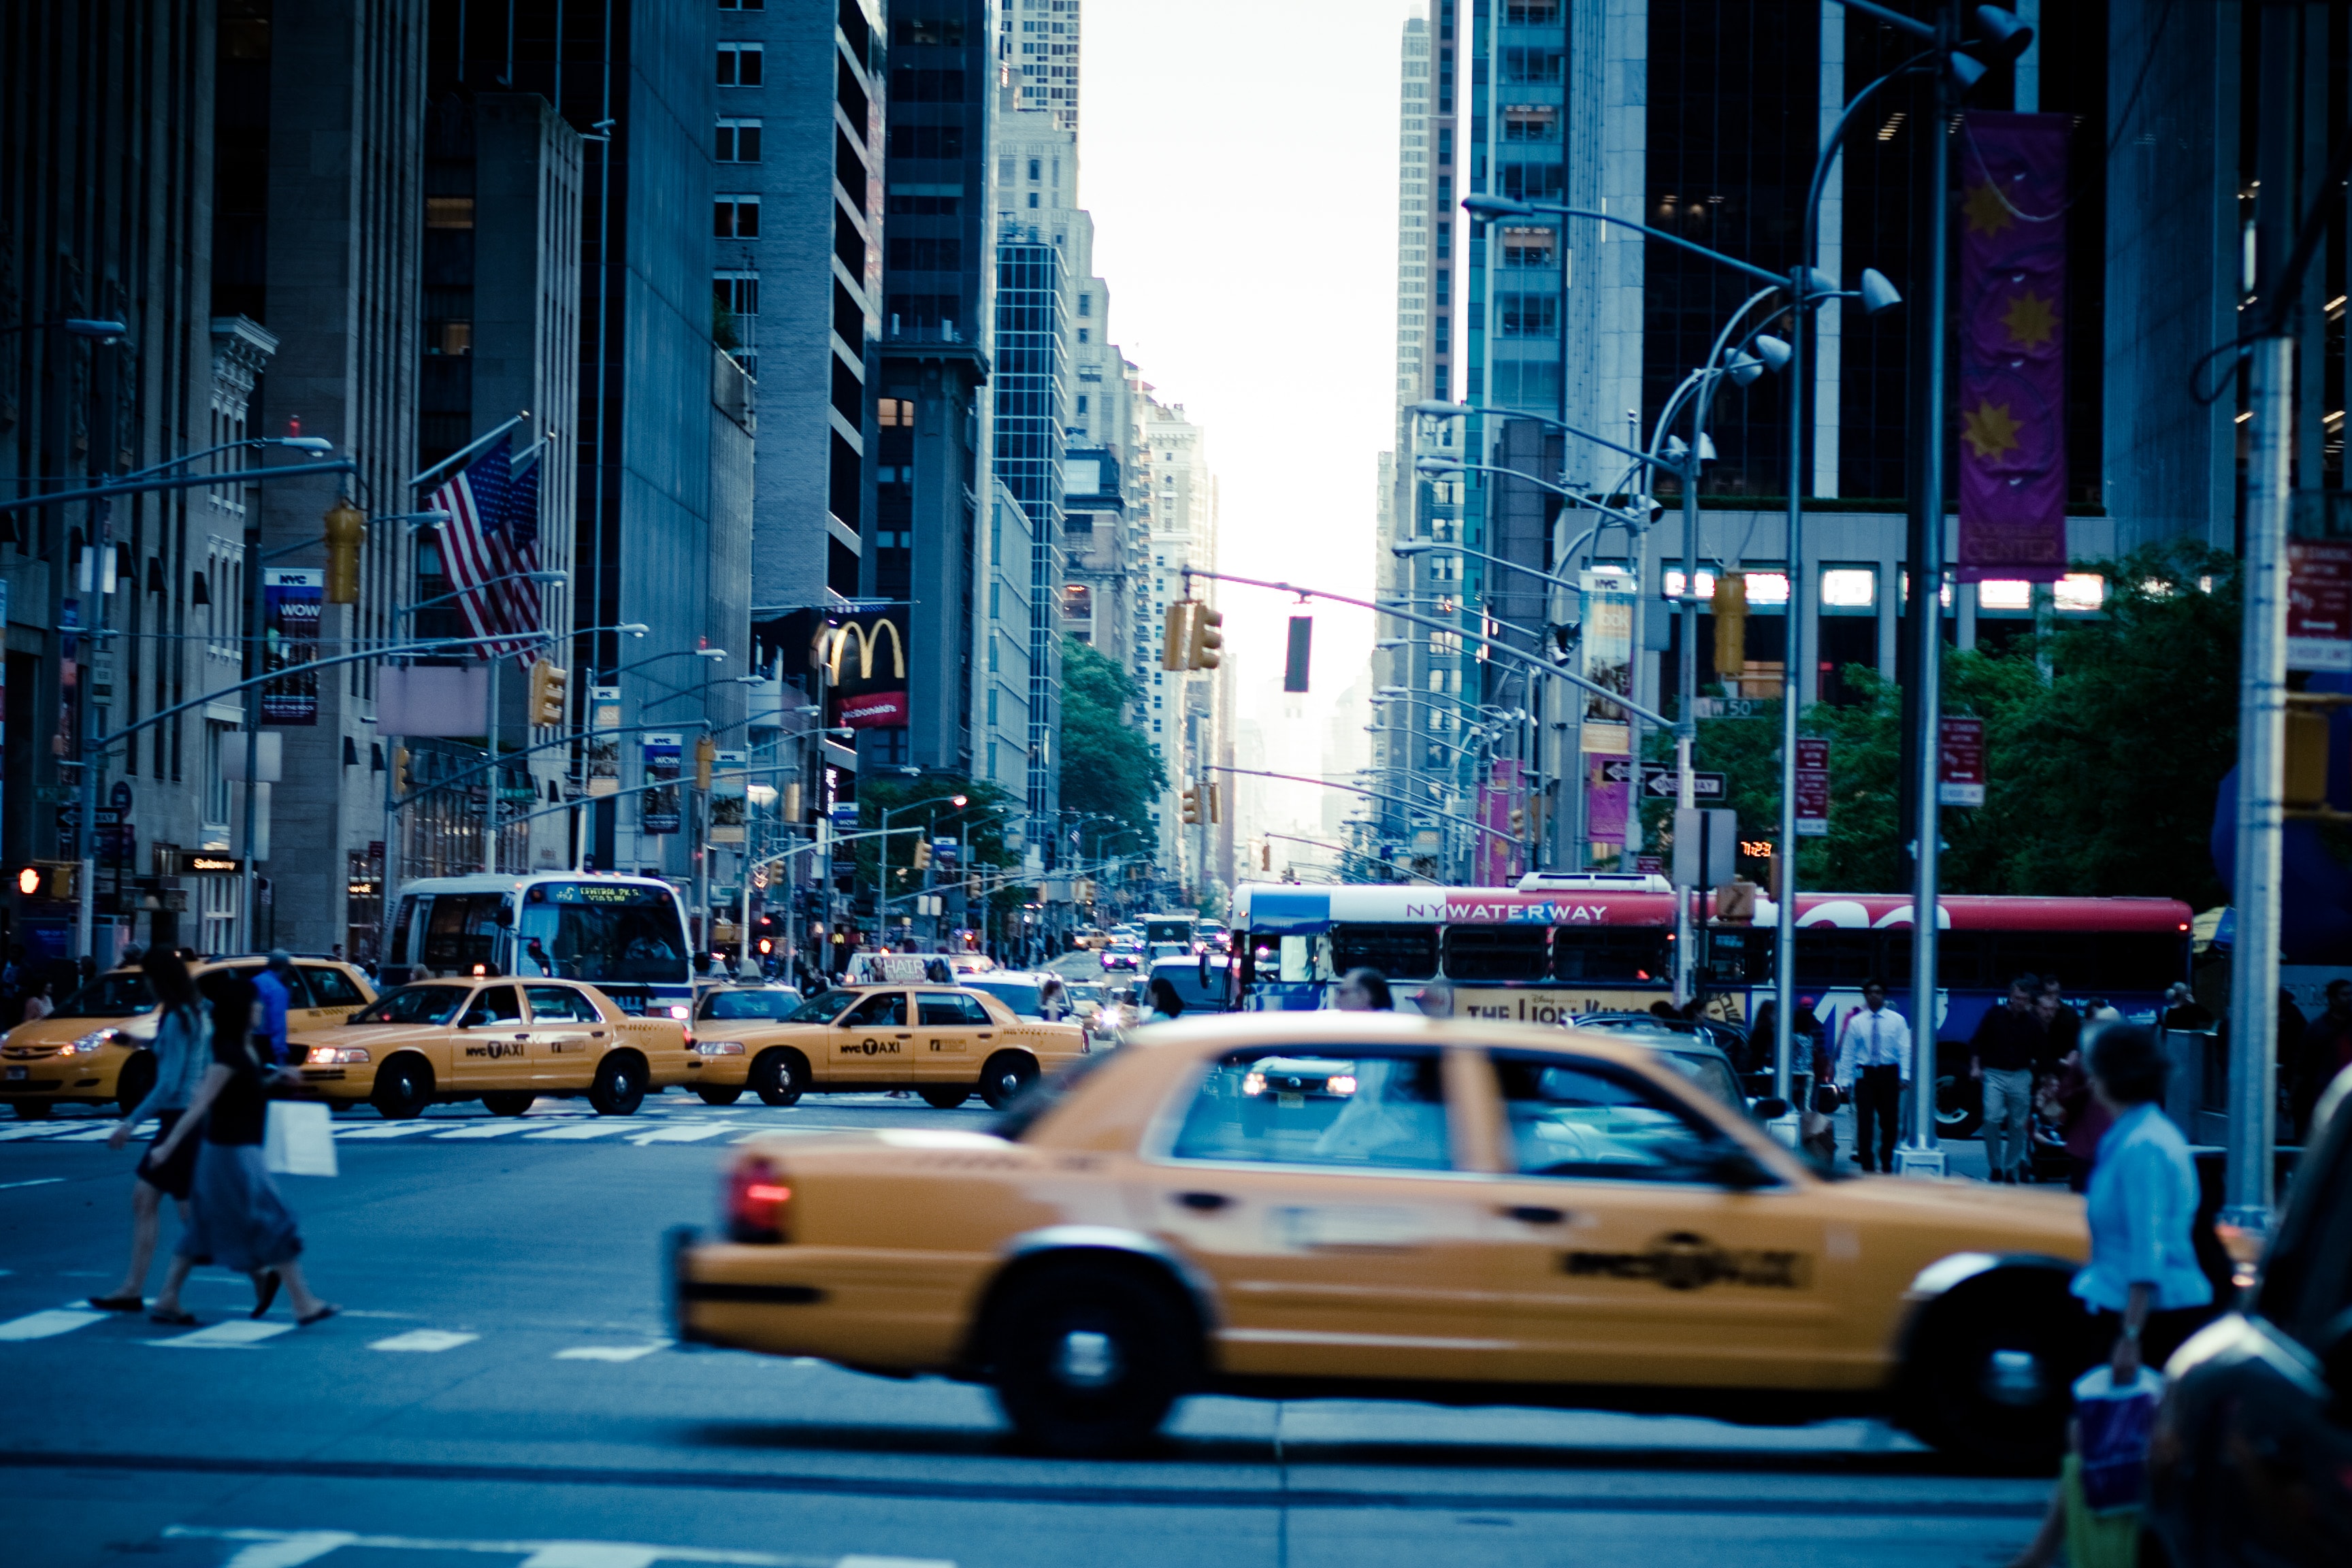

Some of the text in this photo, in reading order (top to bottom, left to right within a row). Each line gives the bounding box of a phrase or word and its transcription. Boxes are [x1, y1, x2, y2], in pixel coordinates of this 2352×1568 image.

[280, 574, 306, 585] NYC
[1595, 579, 1618, 589] NYC
[280, 604, 321, 616] WOW
[1729, 701, 1752, 715] 50
[193, 859, 236, 871] Subway
[883, 959, 926, 975] HAIR
[1467, 1006, 1509, 1019] THE
[466, 1041, 524, 1059] NYC TAXI
[840, 1038, 900, 1056] NYC TAXI
